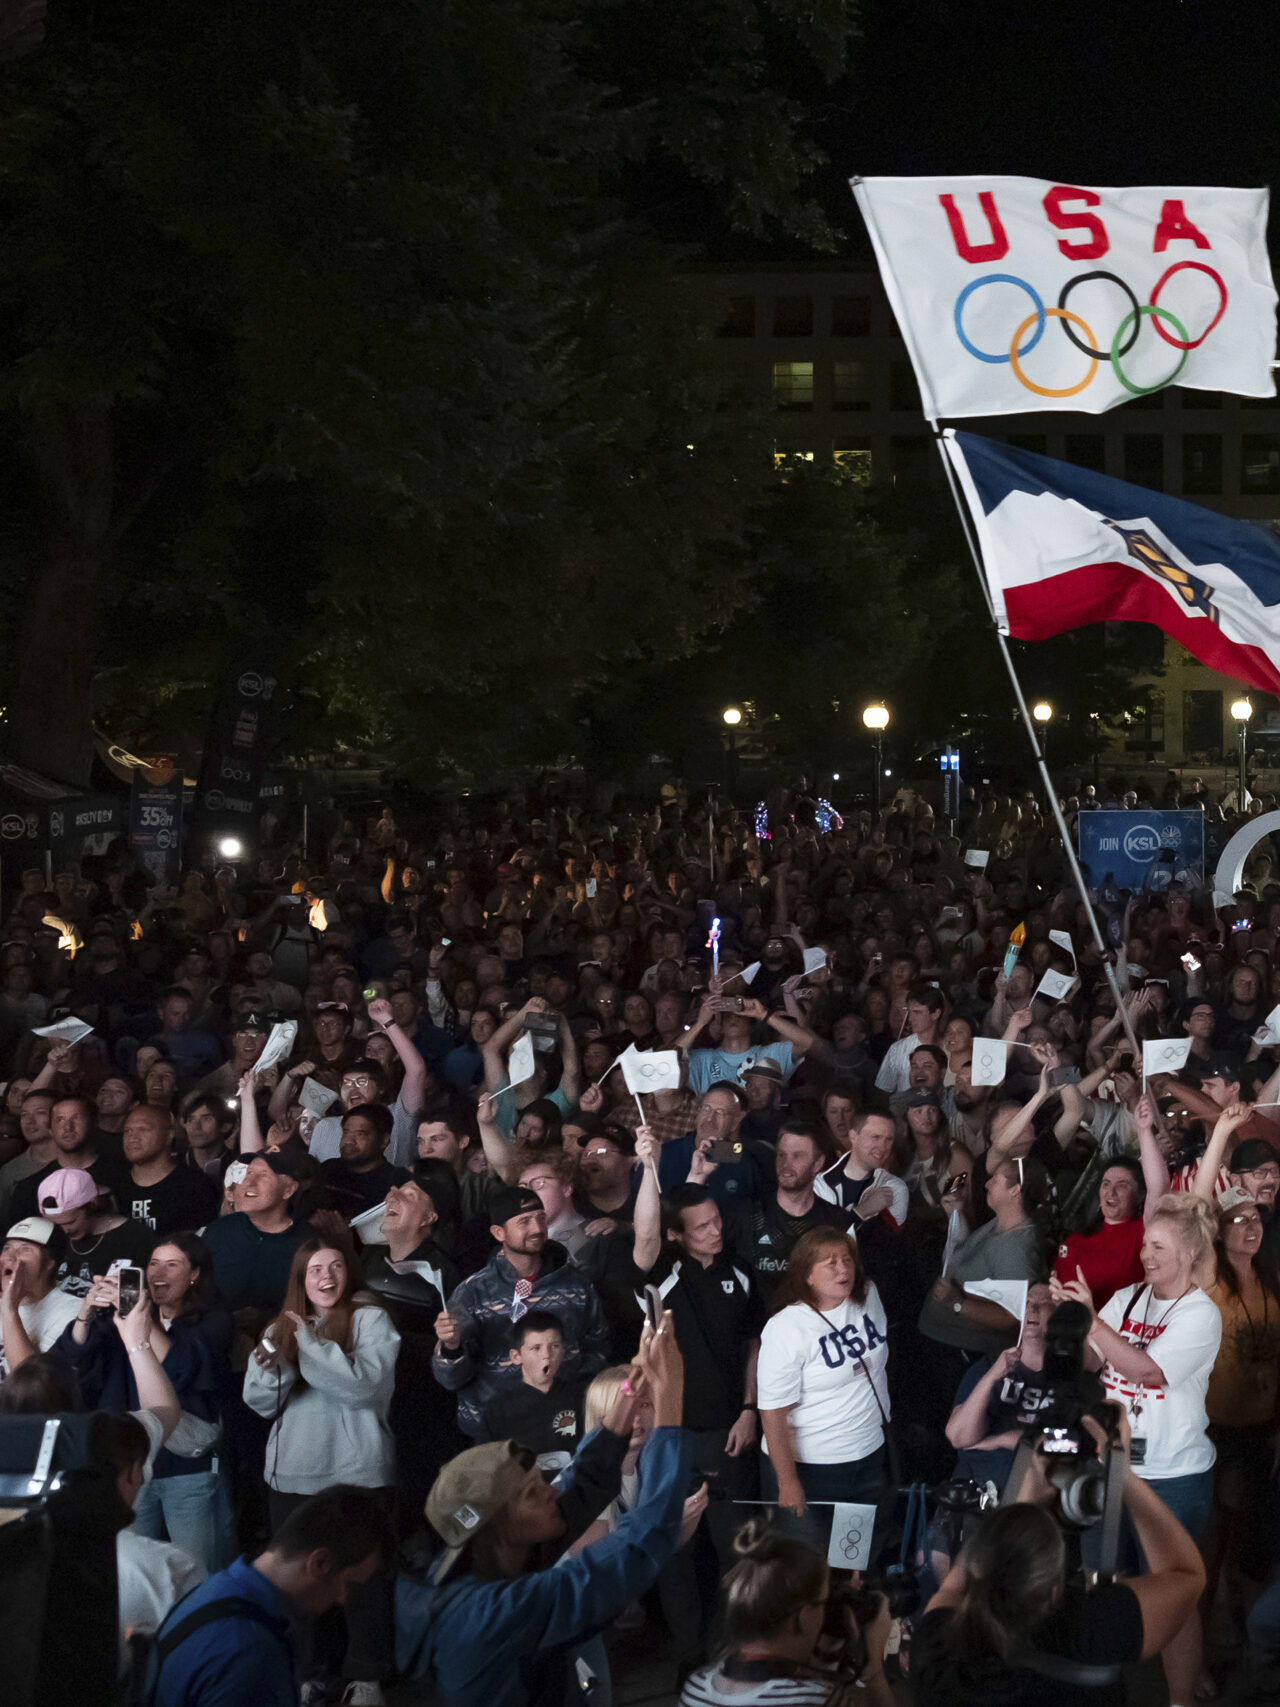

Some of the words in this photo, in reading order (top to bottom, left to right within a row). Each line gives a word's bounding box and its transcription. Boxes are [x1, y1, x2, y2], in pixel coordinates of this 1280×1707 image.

[938, 186, 1212, 264] USA
[1098, 837, 1119, 852] JOIN
[1127, 836, 1160, 851] KSL
[132, 1199, 152, 1219] BE
[818, 1312, 886, 1369] USA
